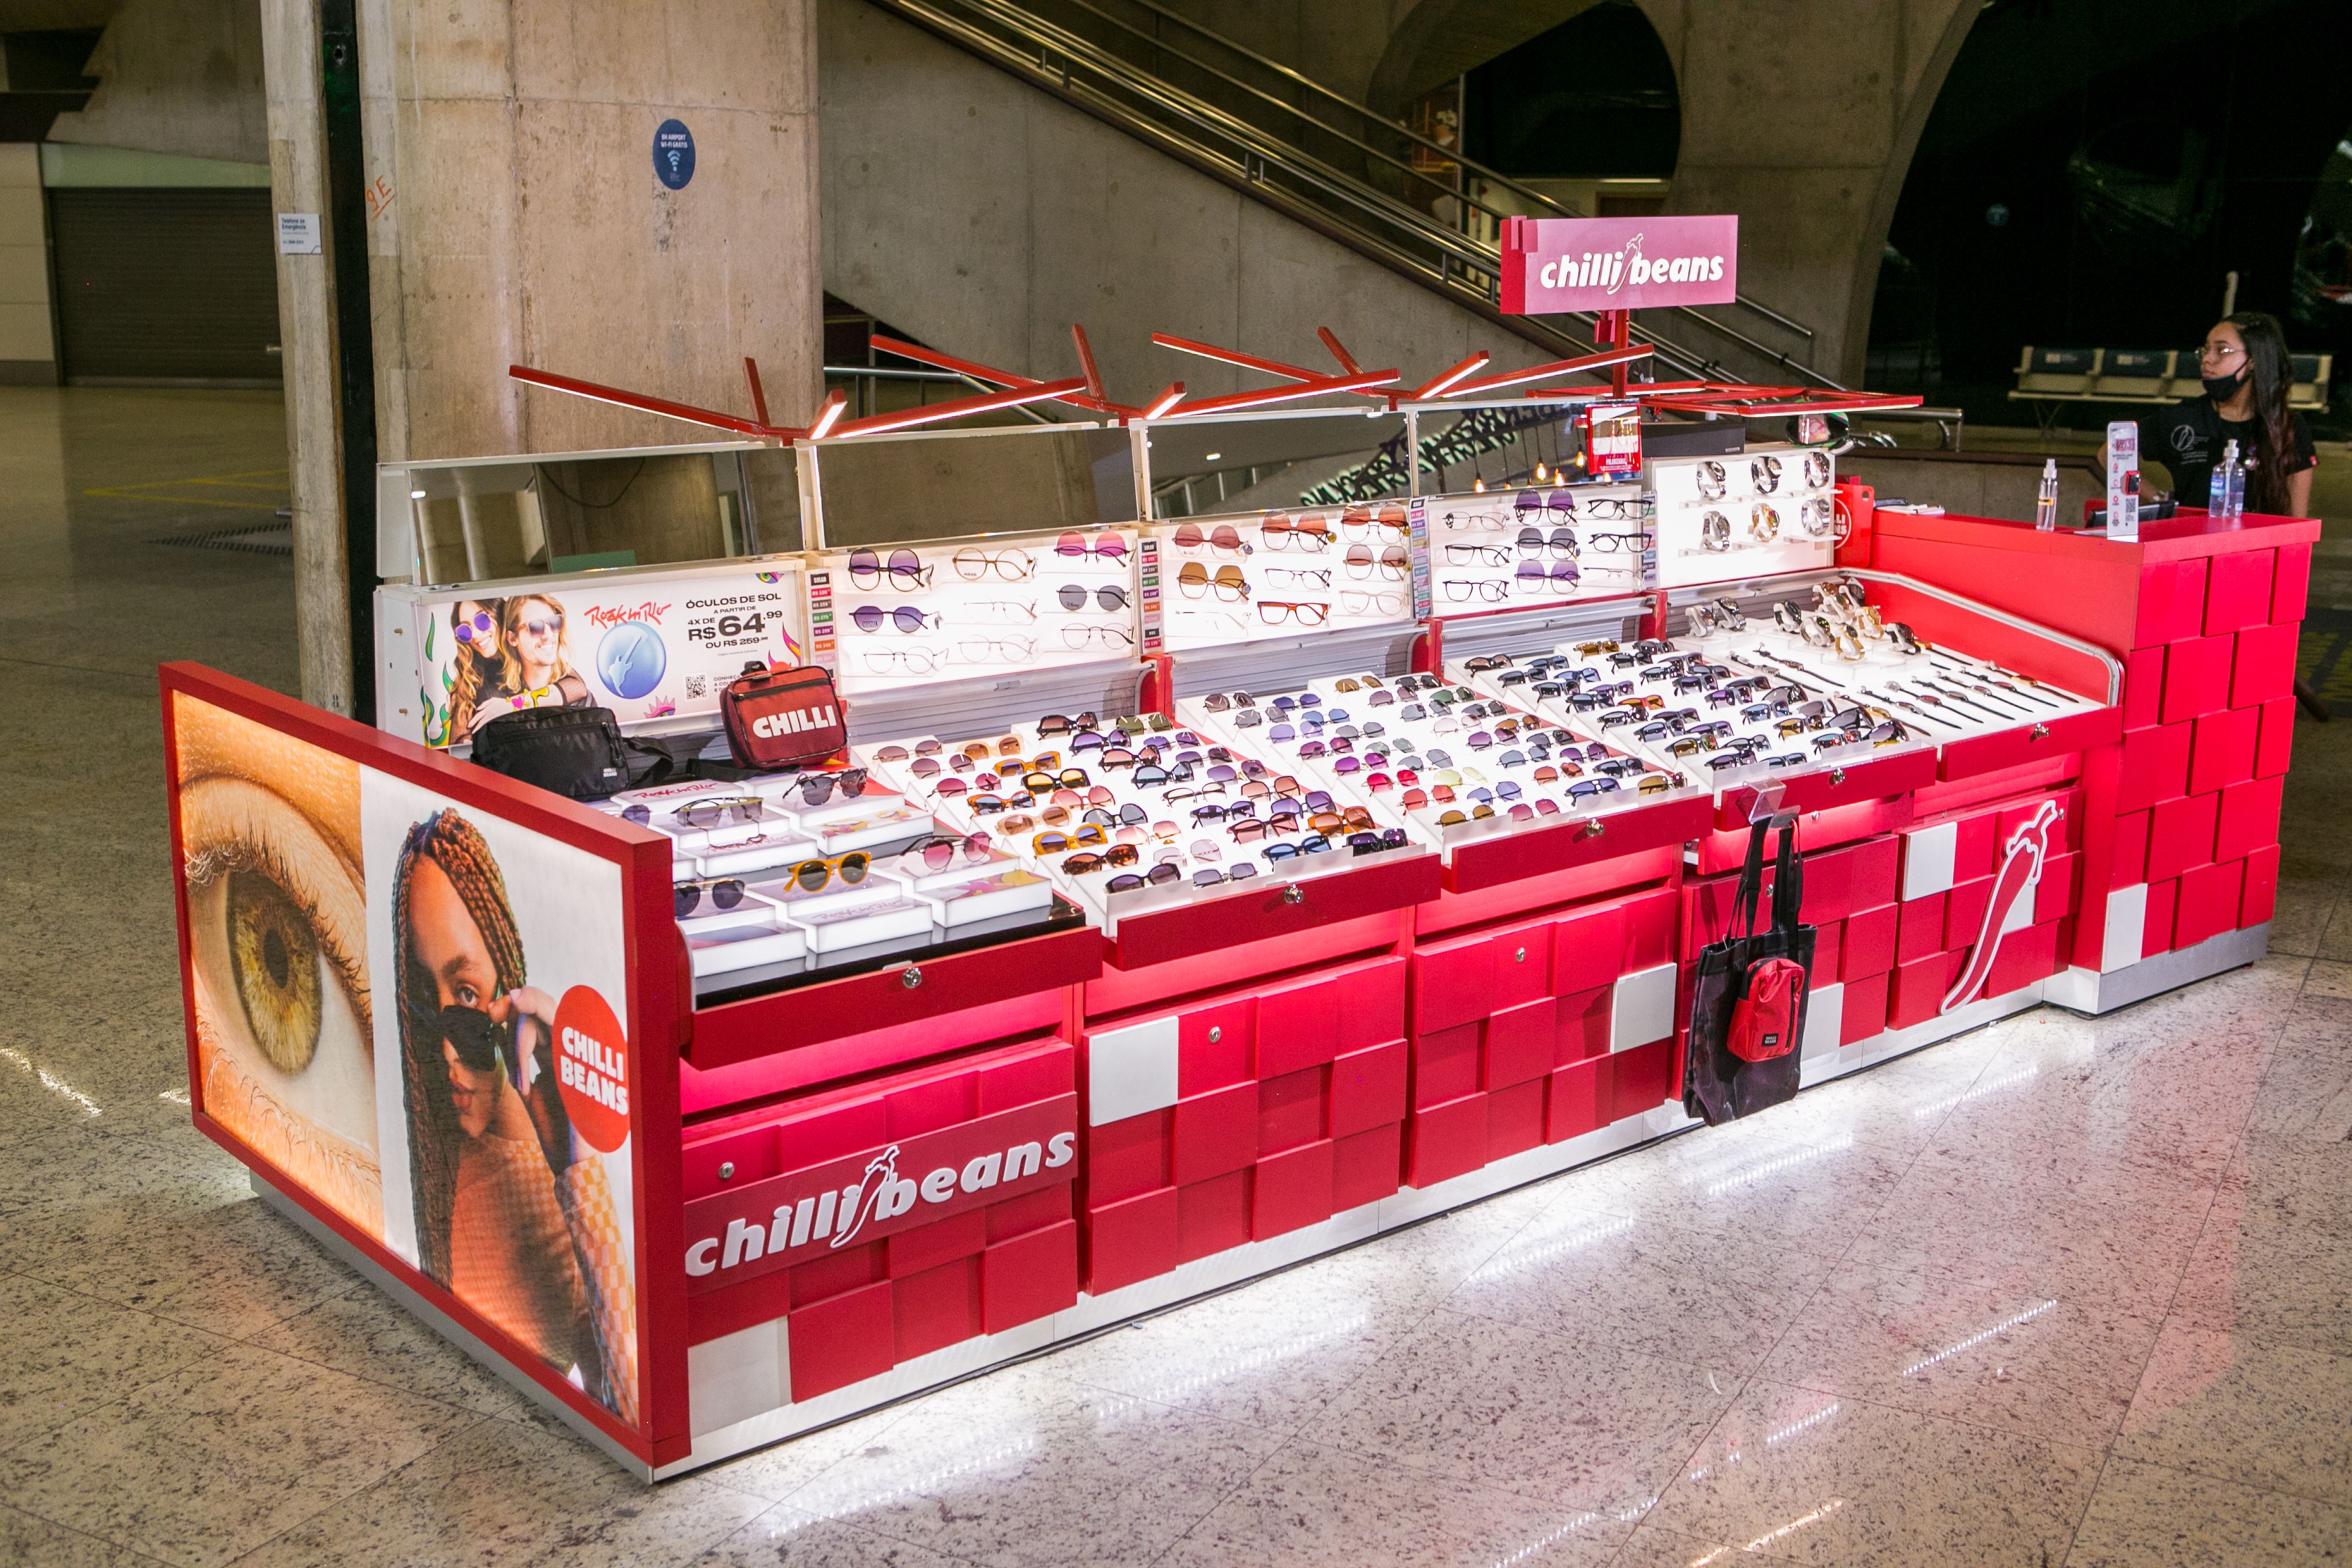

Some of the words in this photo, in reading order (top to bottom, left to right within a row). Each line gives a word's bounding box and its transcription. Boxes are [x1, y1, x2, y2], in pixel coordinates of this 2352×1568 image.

[1540, 252, 1624, 288] chilli
[1628, 252, 1724, 286] beans
[686, 597, 736, 609] ÓCULOS
[740, 595, 755, 603] DE
[758, 593, 781, 602] SOL
[688, 626, 716, 641] R$
[752, 705, 837, 738] CHILLI
[562, 1026, 624, 1082] CHILLI
[560, 1055, 628, 1116] BEANS
[685, 1184, 860, 1277] chilli
[875, 1132, 1075, 1222] beans
